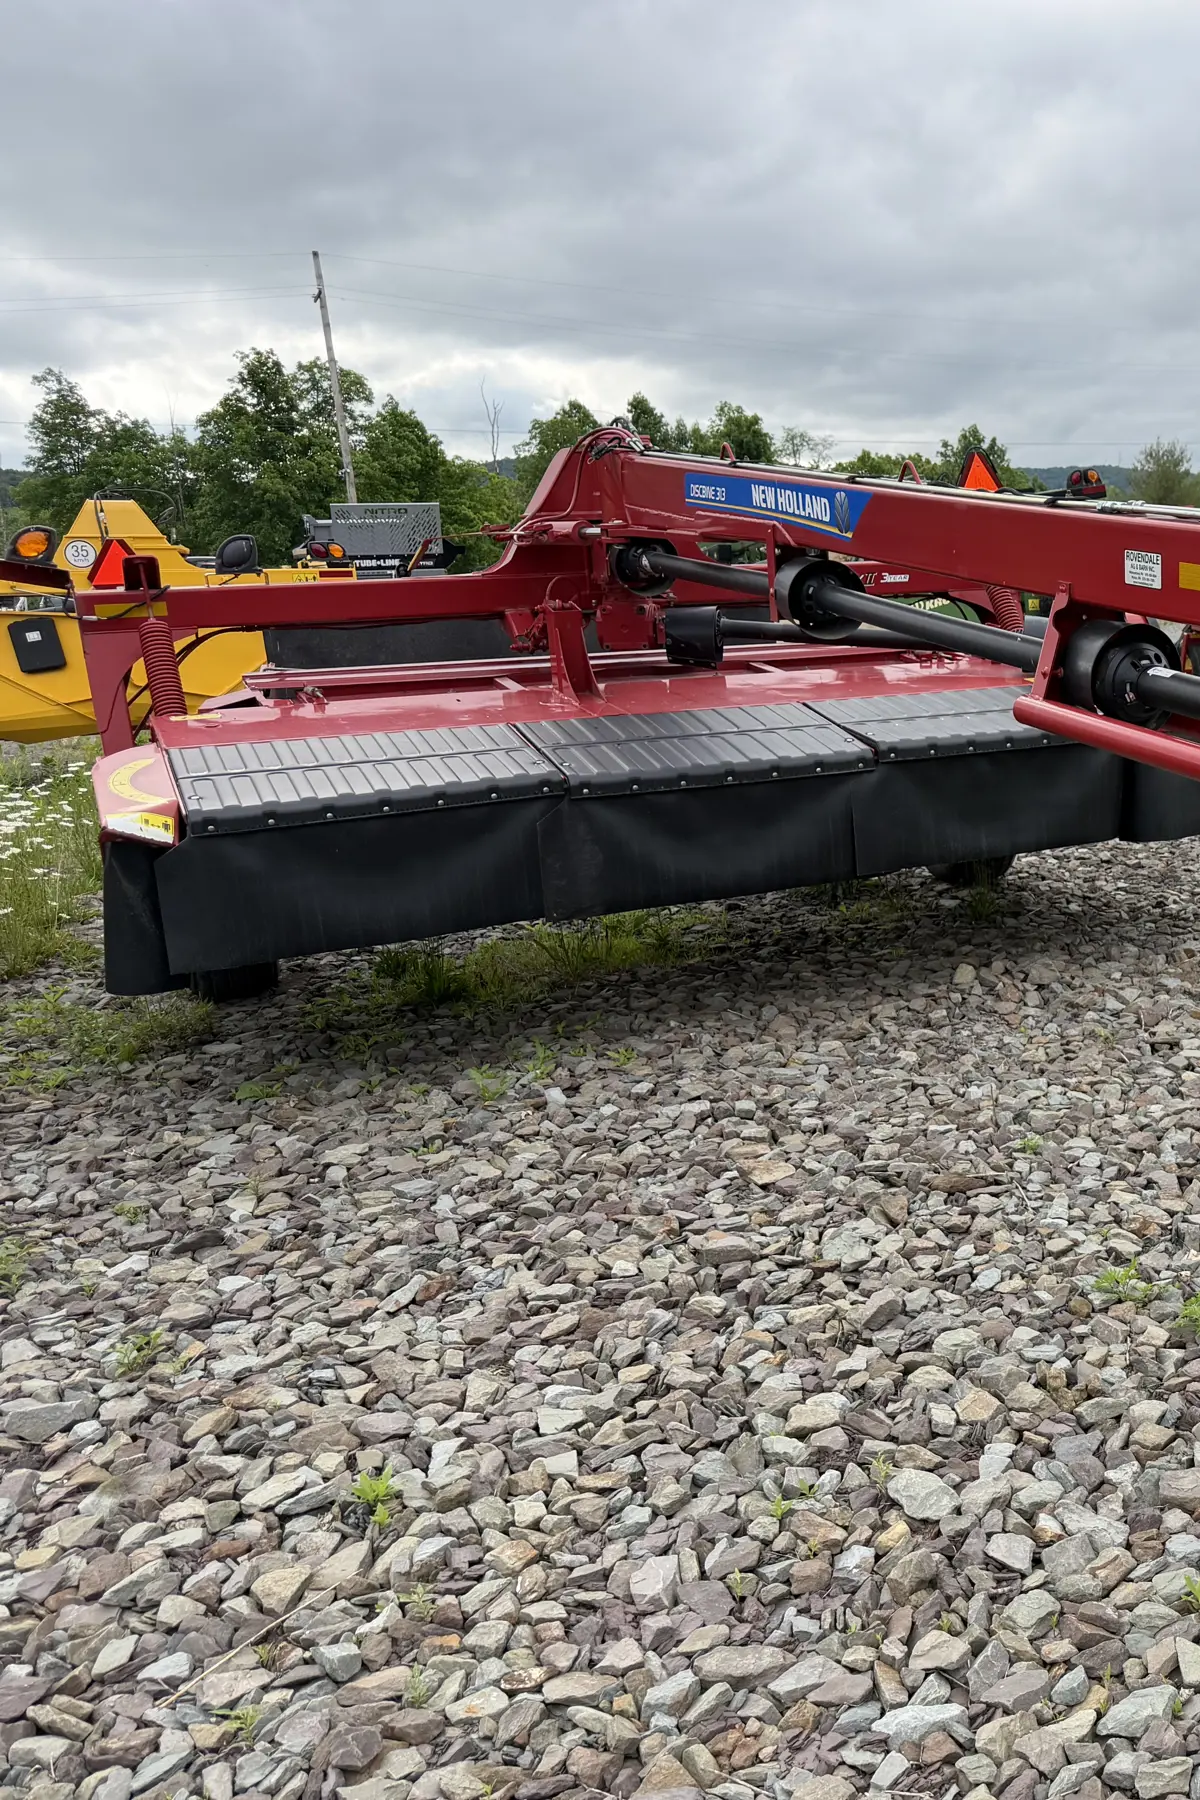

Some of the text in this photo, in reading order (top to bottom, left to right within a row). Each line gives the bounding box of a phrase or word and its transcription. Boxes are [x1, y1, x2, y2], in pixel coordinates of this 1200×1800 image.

[751, 484, 831, 522] NEW HOLLAND
[71, 545, 89, 558] 35
[1126, 551, 1160, 565] ROVENDALE
